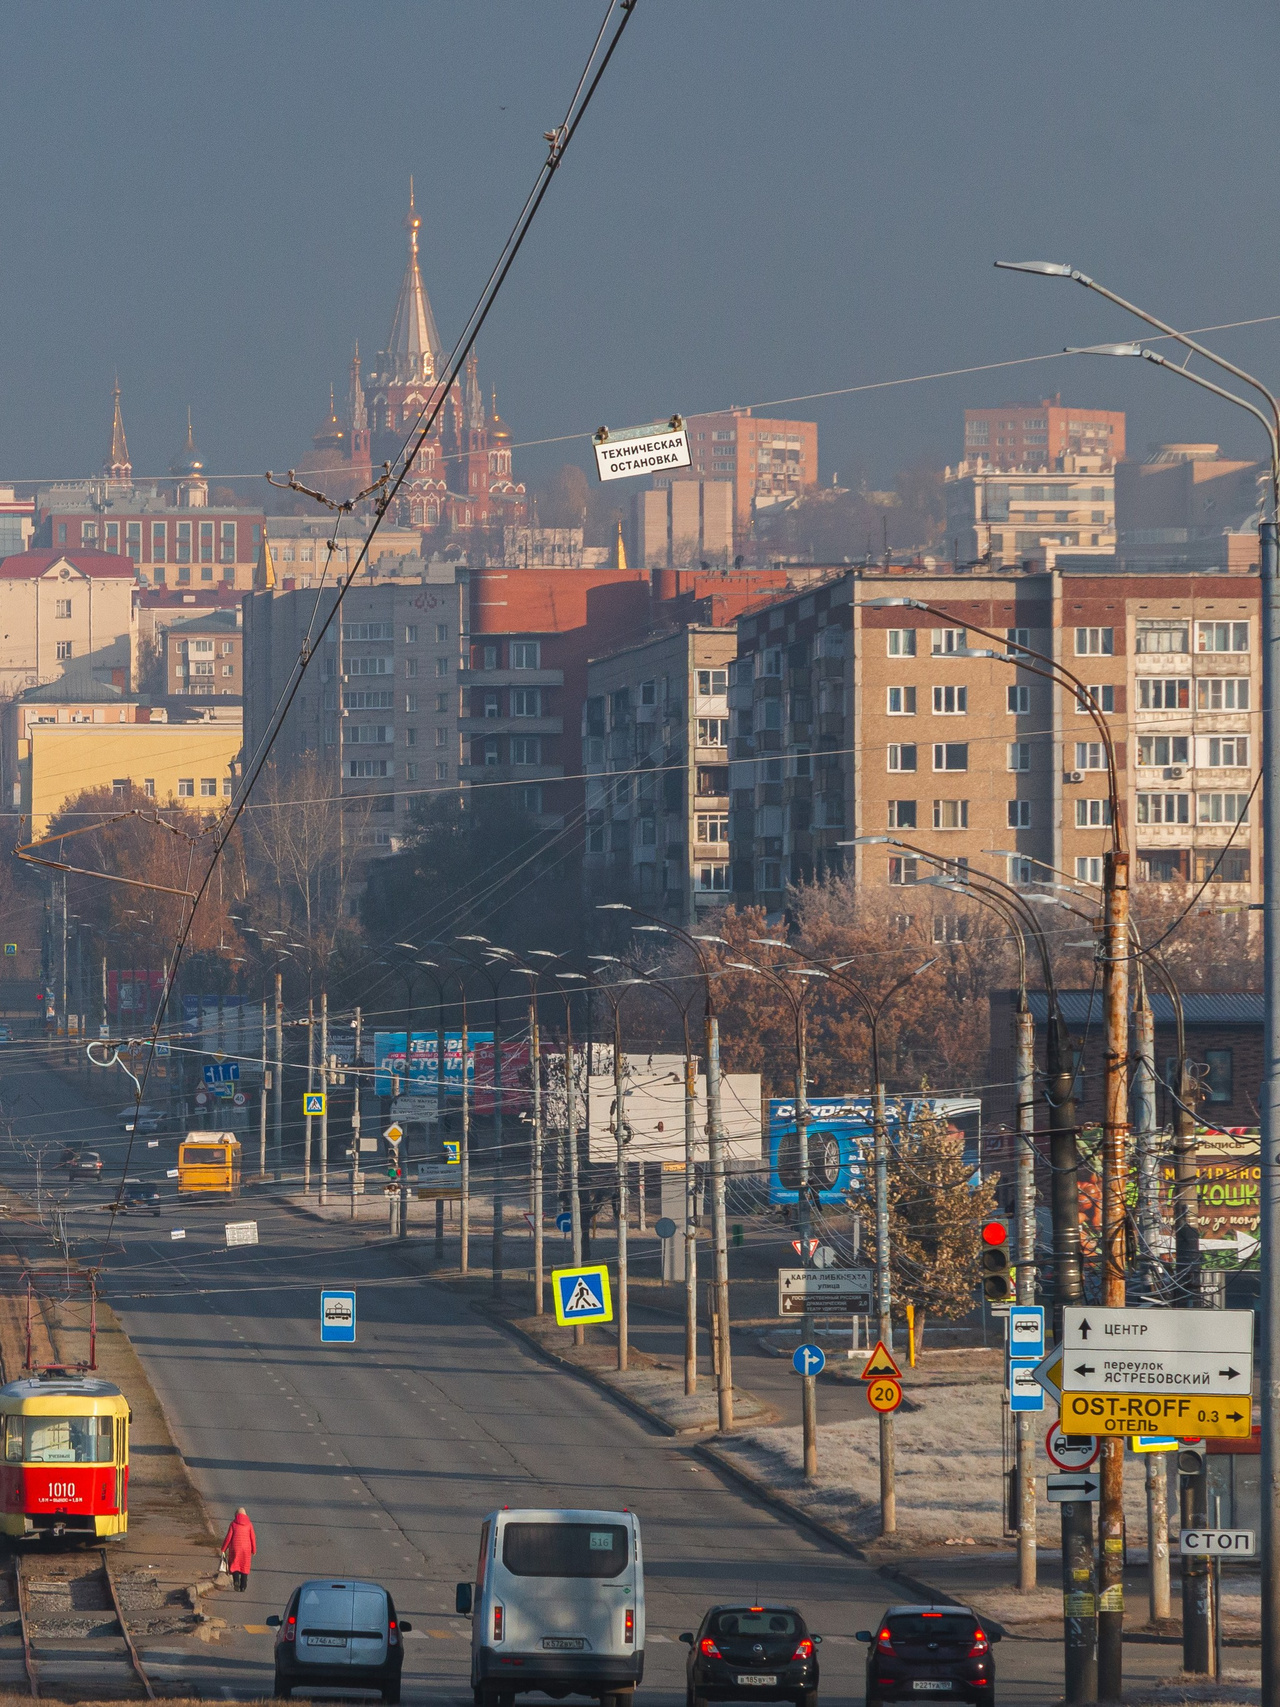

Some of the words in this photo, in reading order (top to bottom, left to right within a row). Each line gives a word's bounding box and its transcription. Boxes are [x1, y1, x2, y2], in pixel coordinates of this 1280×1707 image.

[1104, 1323, 1148, 1337] ЦЕНТР
[1104, 1361, 1164, 1374] переулок
[1104, 1371, 1211, 1386] ЯСТРЕБОВСКИЙ
[874, 1387, 895, 1401] 20
[1071, 1397, 1191, 1418] OST-ROFF
[1197, 1410, 1219, 1423] 0.3
[1104, 1419, 1159, 1432] ОТЕЛЬ
[601, 1438, 683, 1459] ТЕХНИЧЕСКАЯ
[610, 1453, 679, 1473] ОСТАНОВКА
[48, 1482, 76, 1498] 1010
[591, 1538, 609, 1547] 516
[1185, 1532, 1250, 1551] СТОП
